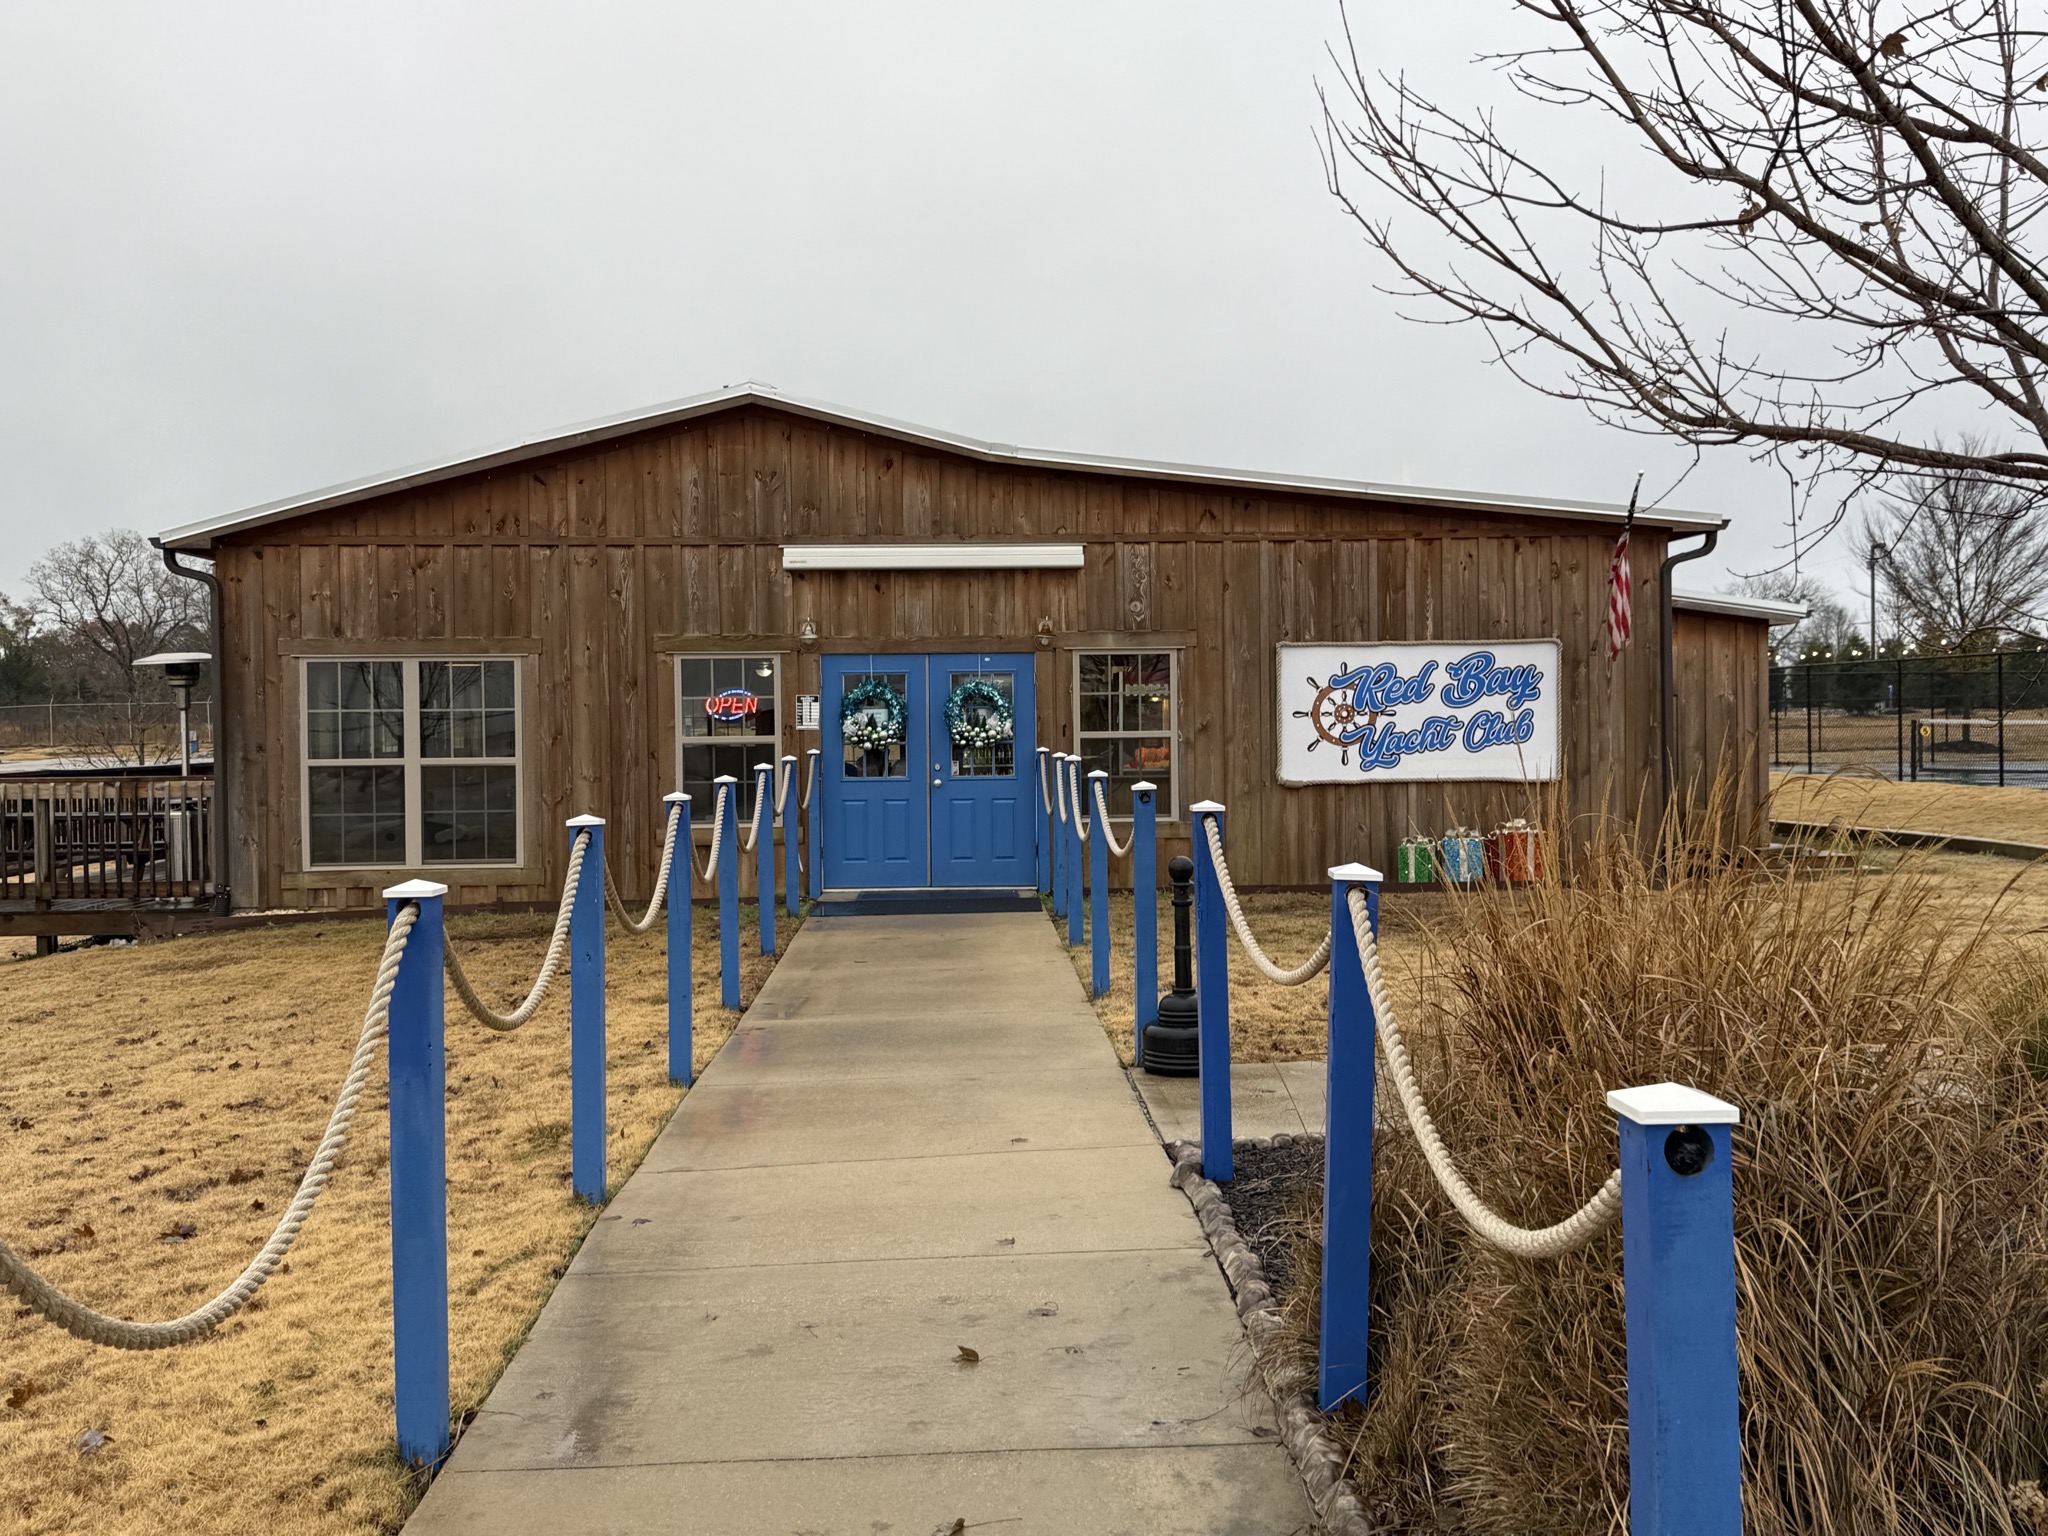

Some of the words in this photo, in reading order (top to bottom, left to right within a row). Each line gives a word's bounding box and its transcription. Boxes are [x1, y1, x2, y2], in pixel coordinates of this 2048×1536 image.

[705, 696, 758, 714] OPEN
[1329, 660, 1438, 712] Red
[1441, 651, 1544, 709] Bay
[1341, 715, 1463, 772] Yacht
[1463, 709, 1535, 753] Club
